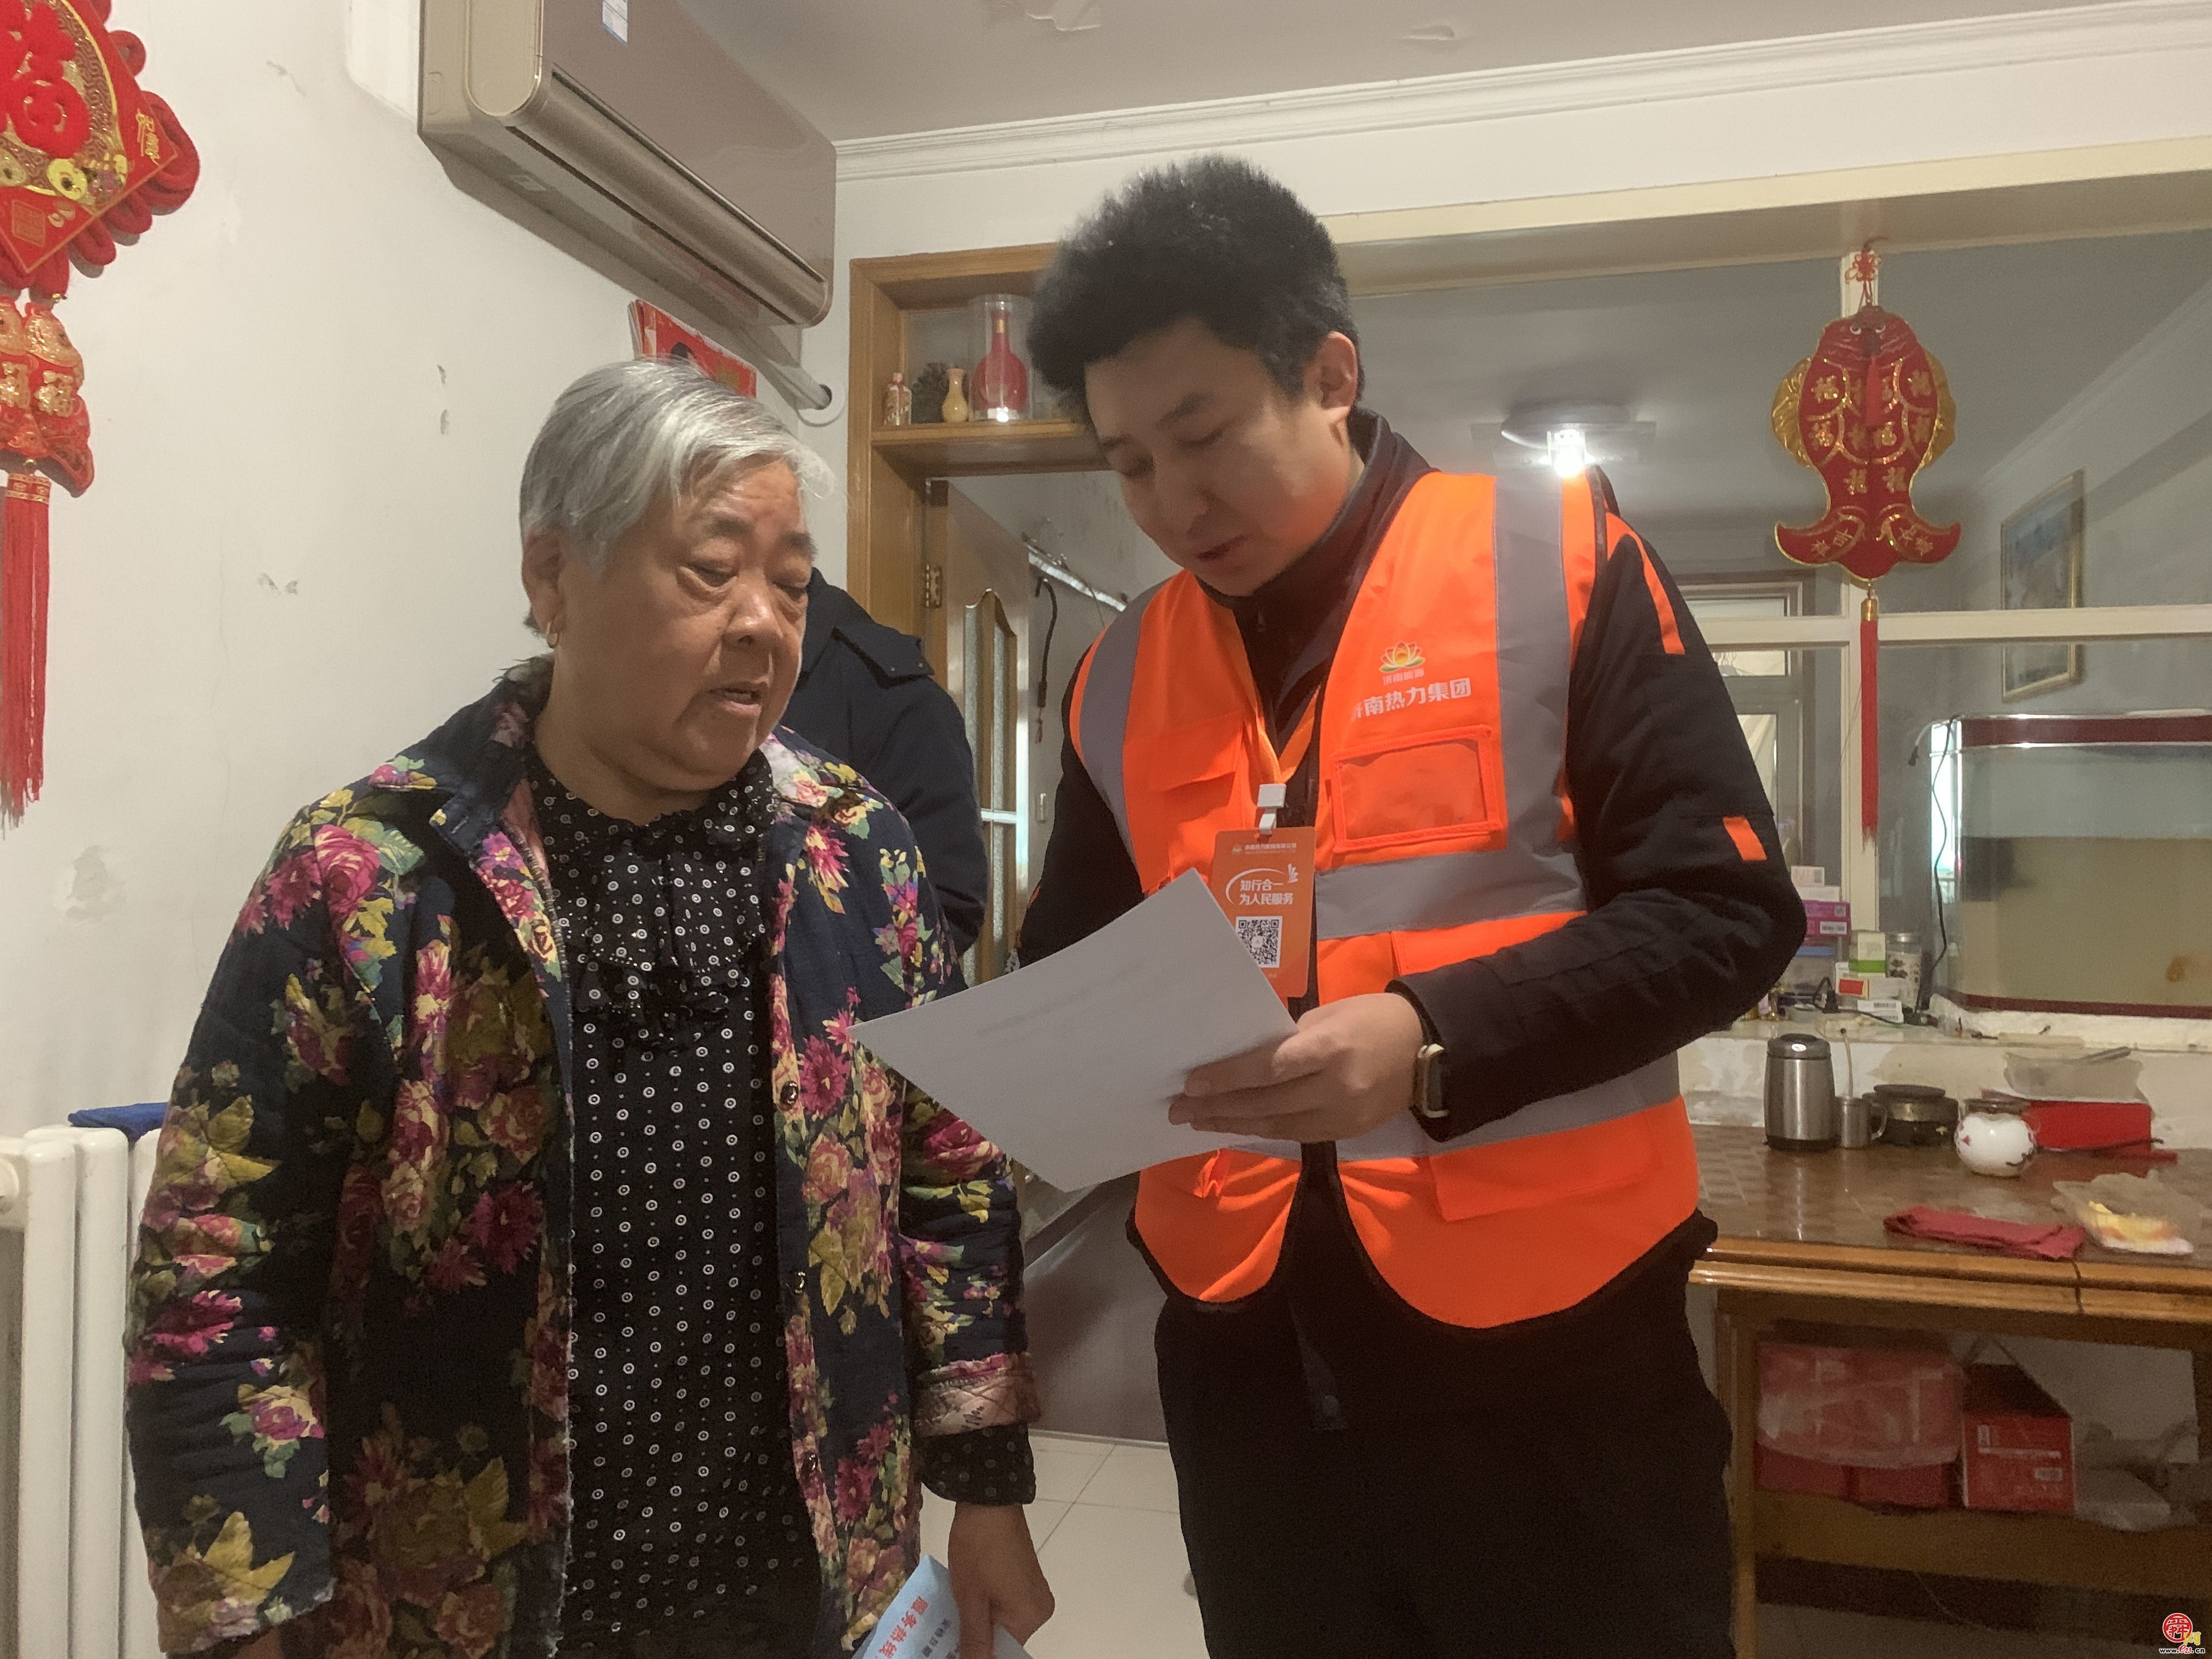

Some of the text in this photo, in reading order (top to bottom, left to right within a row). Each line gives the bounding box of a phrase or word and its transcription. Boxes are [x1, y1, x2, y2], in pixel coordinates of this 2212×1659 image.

[1240, 879, 1284, 891] 知行合一
[1239, 893, 1294, 905] 为人民服务
